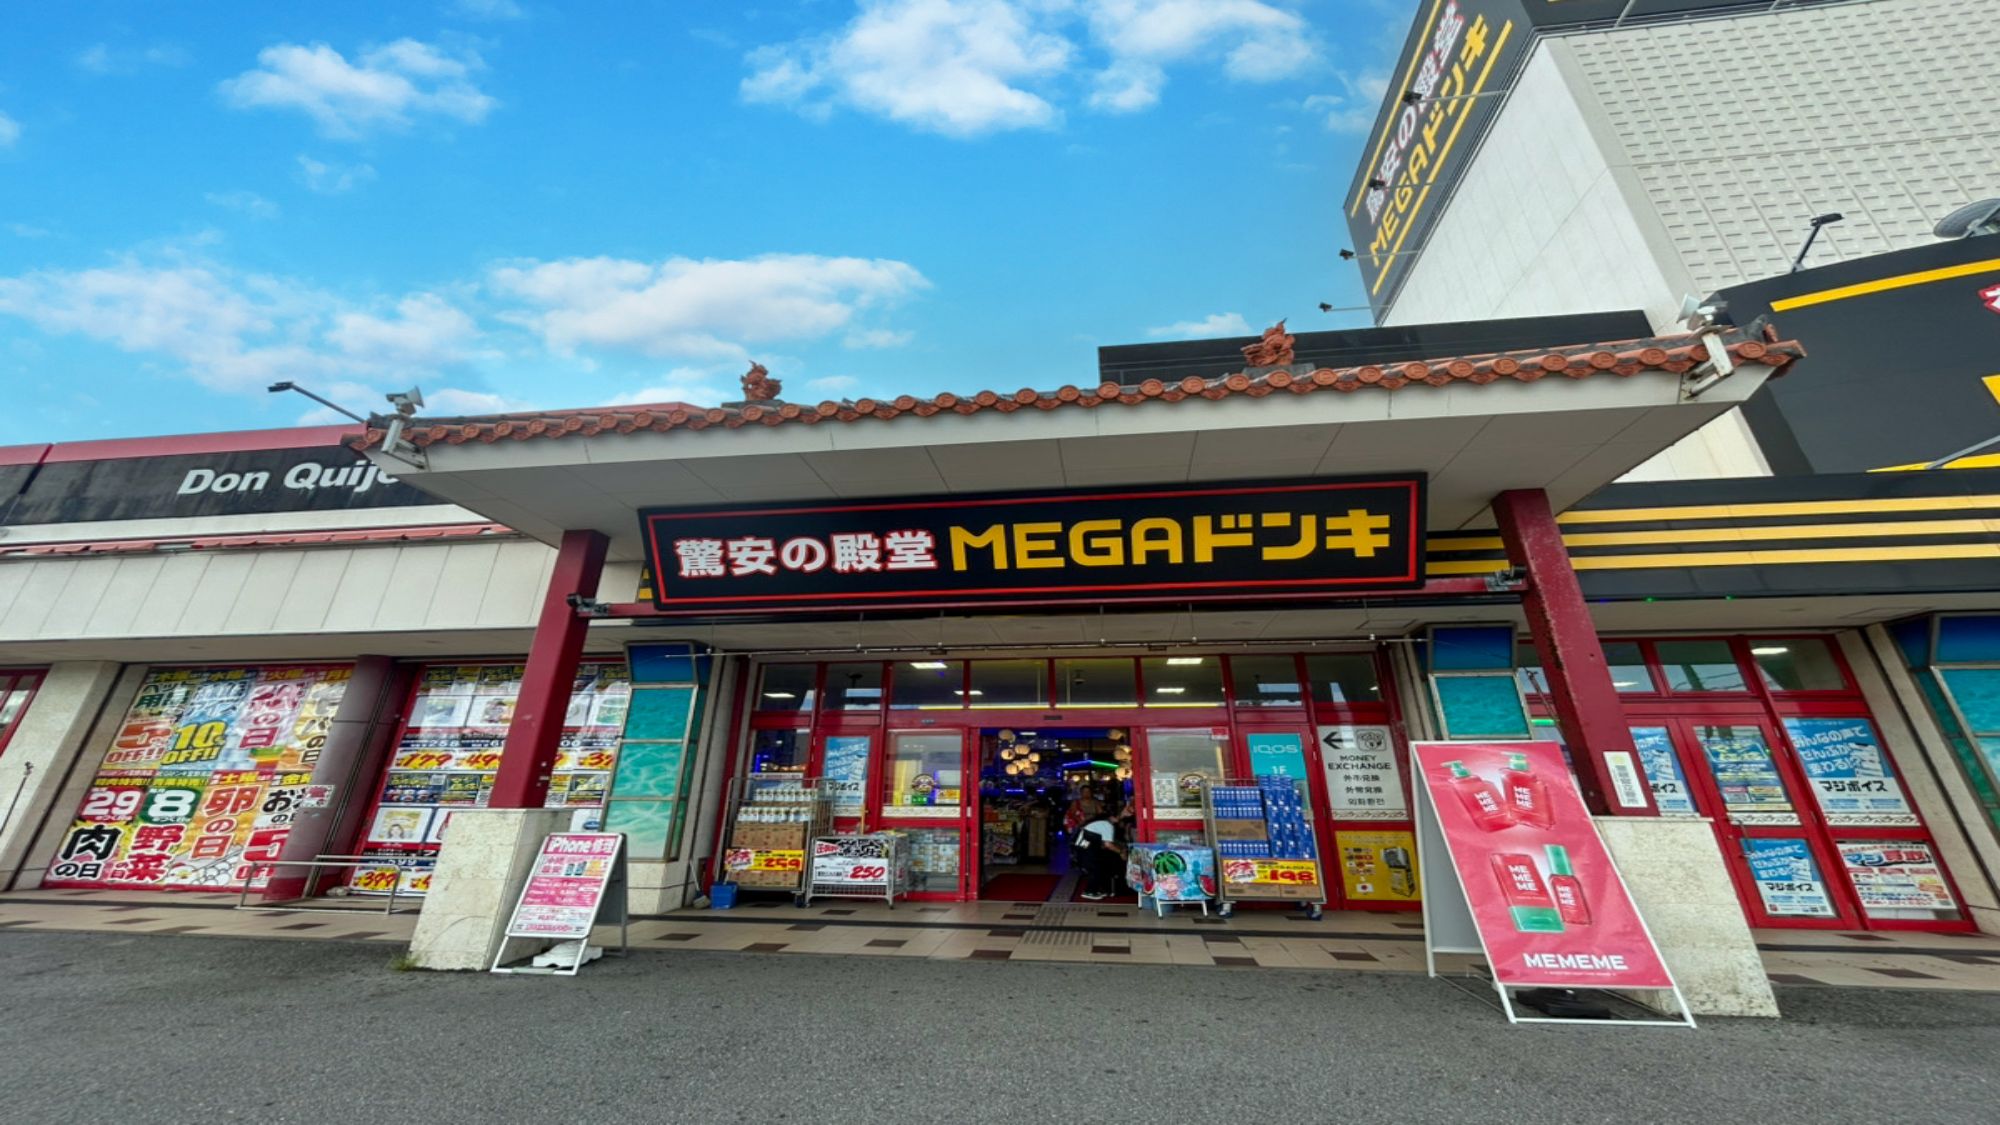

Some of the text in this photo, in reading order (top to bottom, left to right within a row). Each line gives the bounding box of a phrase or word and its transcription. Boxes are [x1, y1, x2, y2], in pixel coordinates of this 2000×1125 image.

[1369, 13, 1489, 268] MEGAドンキ
[177, 468, 270, 495] Don
[674, 508, 1391, 580] 驚安の殿堂 MEGAドンキ
[1253, 745, 1299, 754] IQOS
[1328, 762, 1392, 770] EXCHANGE
[1818, 780, 1888, 792] マジボイス
[82, 790, 141, 816] 29
[148, 789, 195, 817] 8
[61, 825, 122, 860] 肉
[547, 836, 592, 853] iPhone
[850, 865, 886, 879] 250
[1522, 953, 1628, 970] MEMEME
